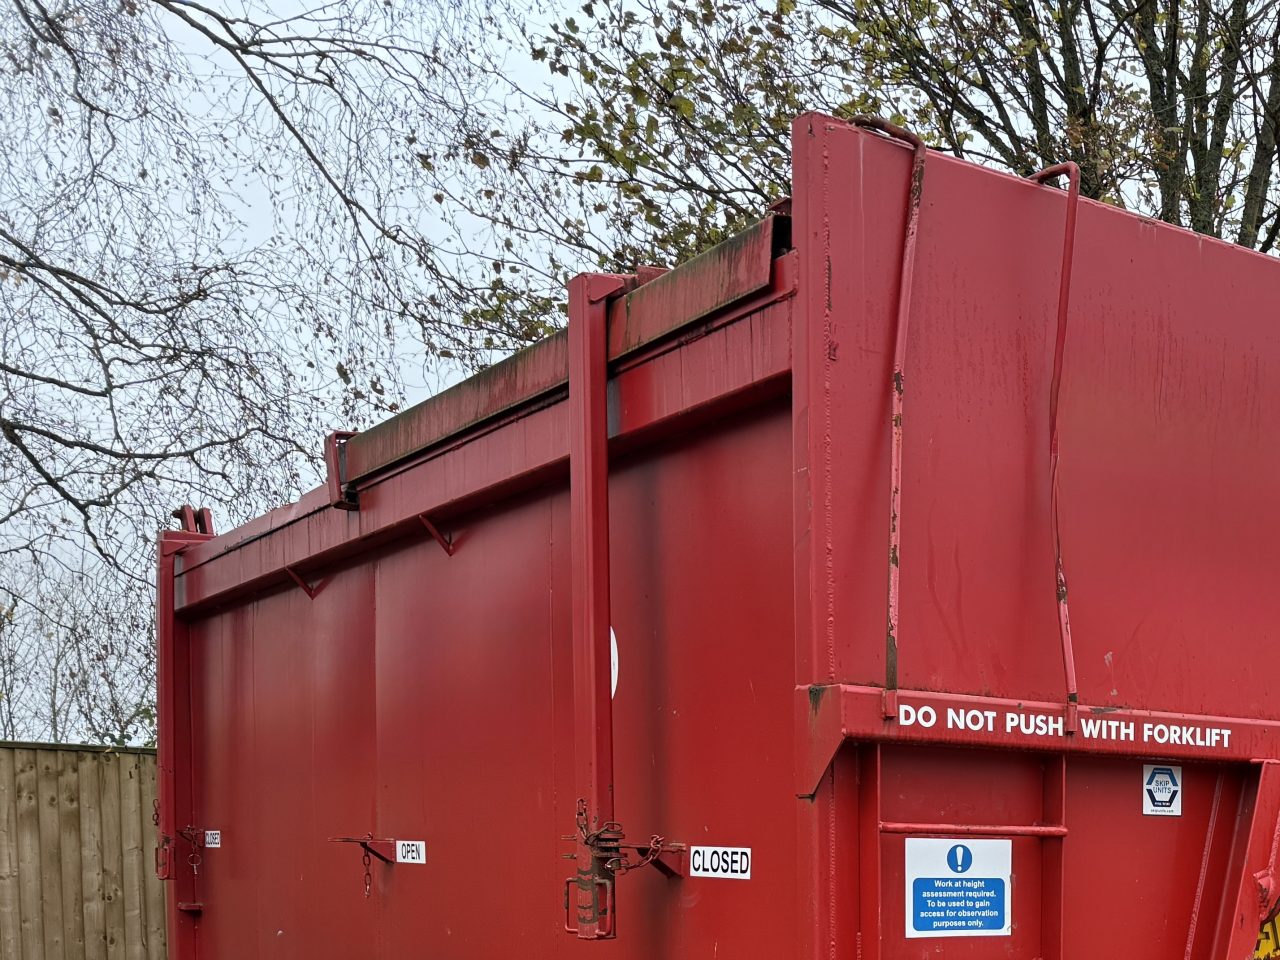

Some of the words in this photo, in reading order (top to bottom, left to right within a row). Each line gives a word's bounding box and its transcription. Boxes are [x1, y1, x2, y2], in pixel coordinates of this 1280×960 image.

[899, 704, 937, 728] DO
[947, 707, 997, 732] NOT
[1005, 712, 1064, 737] PUSH
[1081, 718, 1135, 742] WITH
[1143, 723, 1232, 748] FORKLIFT
[1152, 786, 1172, 794] UNITS
[401, 843, 421, 860] OPEN
[692, 849, 750, 874] CLOSED
[934, 880, 953, 888] Work
[954, 880, 962, 888] at
[963, 880, 985, 889] height
[922, 890, 965, 898] assessment
[965, 890, 997, 899] required.
[927, 900, 936, 908] To
[937, 899, 946, 907] be
[947, 899, 965, 907] used
[975, 899, 990, 909] gain
[920, 910, 945, 918] access
[946, 909, 957, 917] for
[957, 909, 999, 917] observation
[933, 920, 966, 929] purposes
[967, 919, 984, 928] only.
